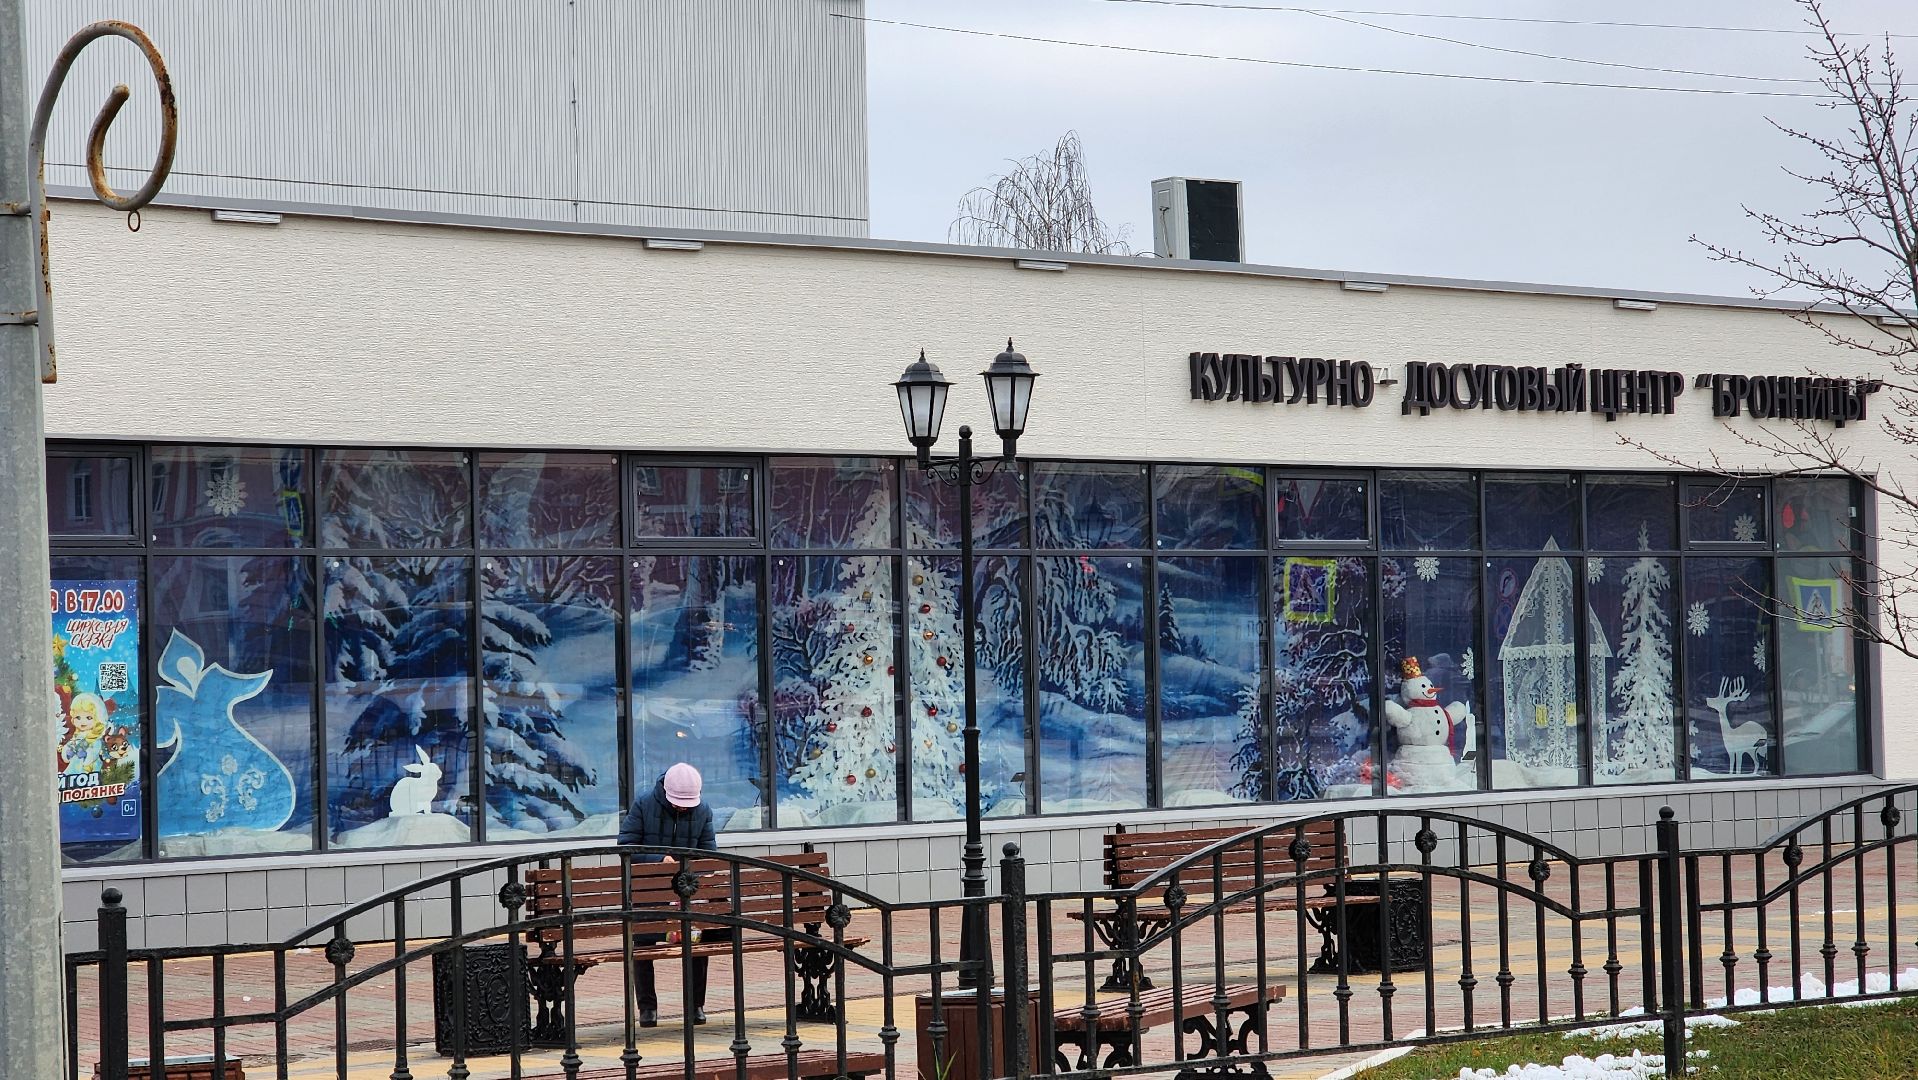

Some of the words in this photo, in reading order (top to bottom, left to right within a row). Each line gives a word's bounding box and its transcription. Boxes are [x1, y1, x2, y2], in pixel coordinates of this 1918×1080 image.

[1189, 352, 1375, 408] КУЛЬТУРНО
[1590, 368, 1684, 421] ЦЕНТР
[78, 589, 124, 613] 17.00
[70, 633, 114, 649] СКАЗКА
[69, 773, 100, 787] ГОД
[63, 783, 124, 802] ПОЛЯНКЕ
